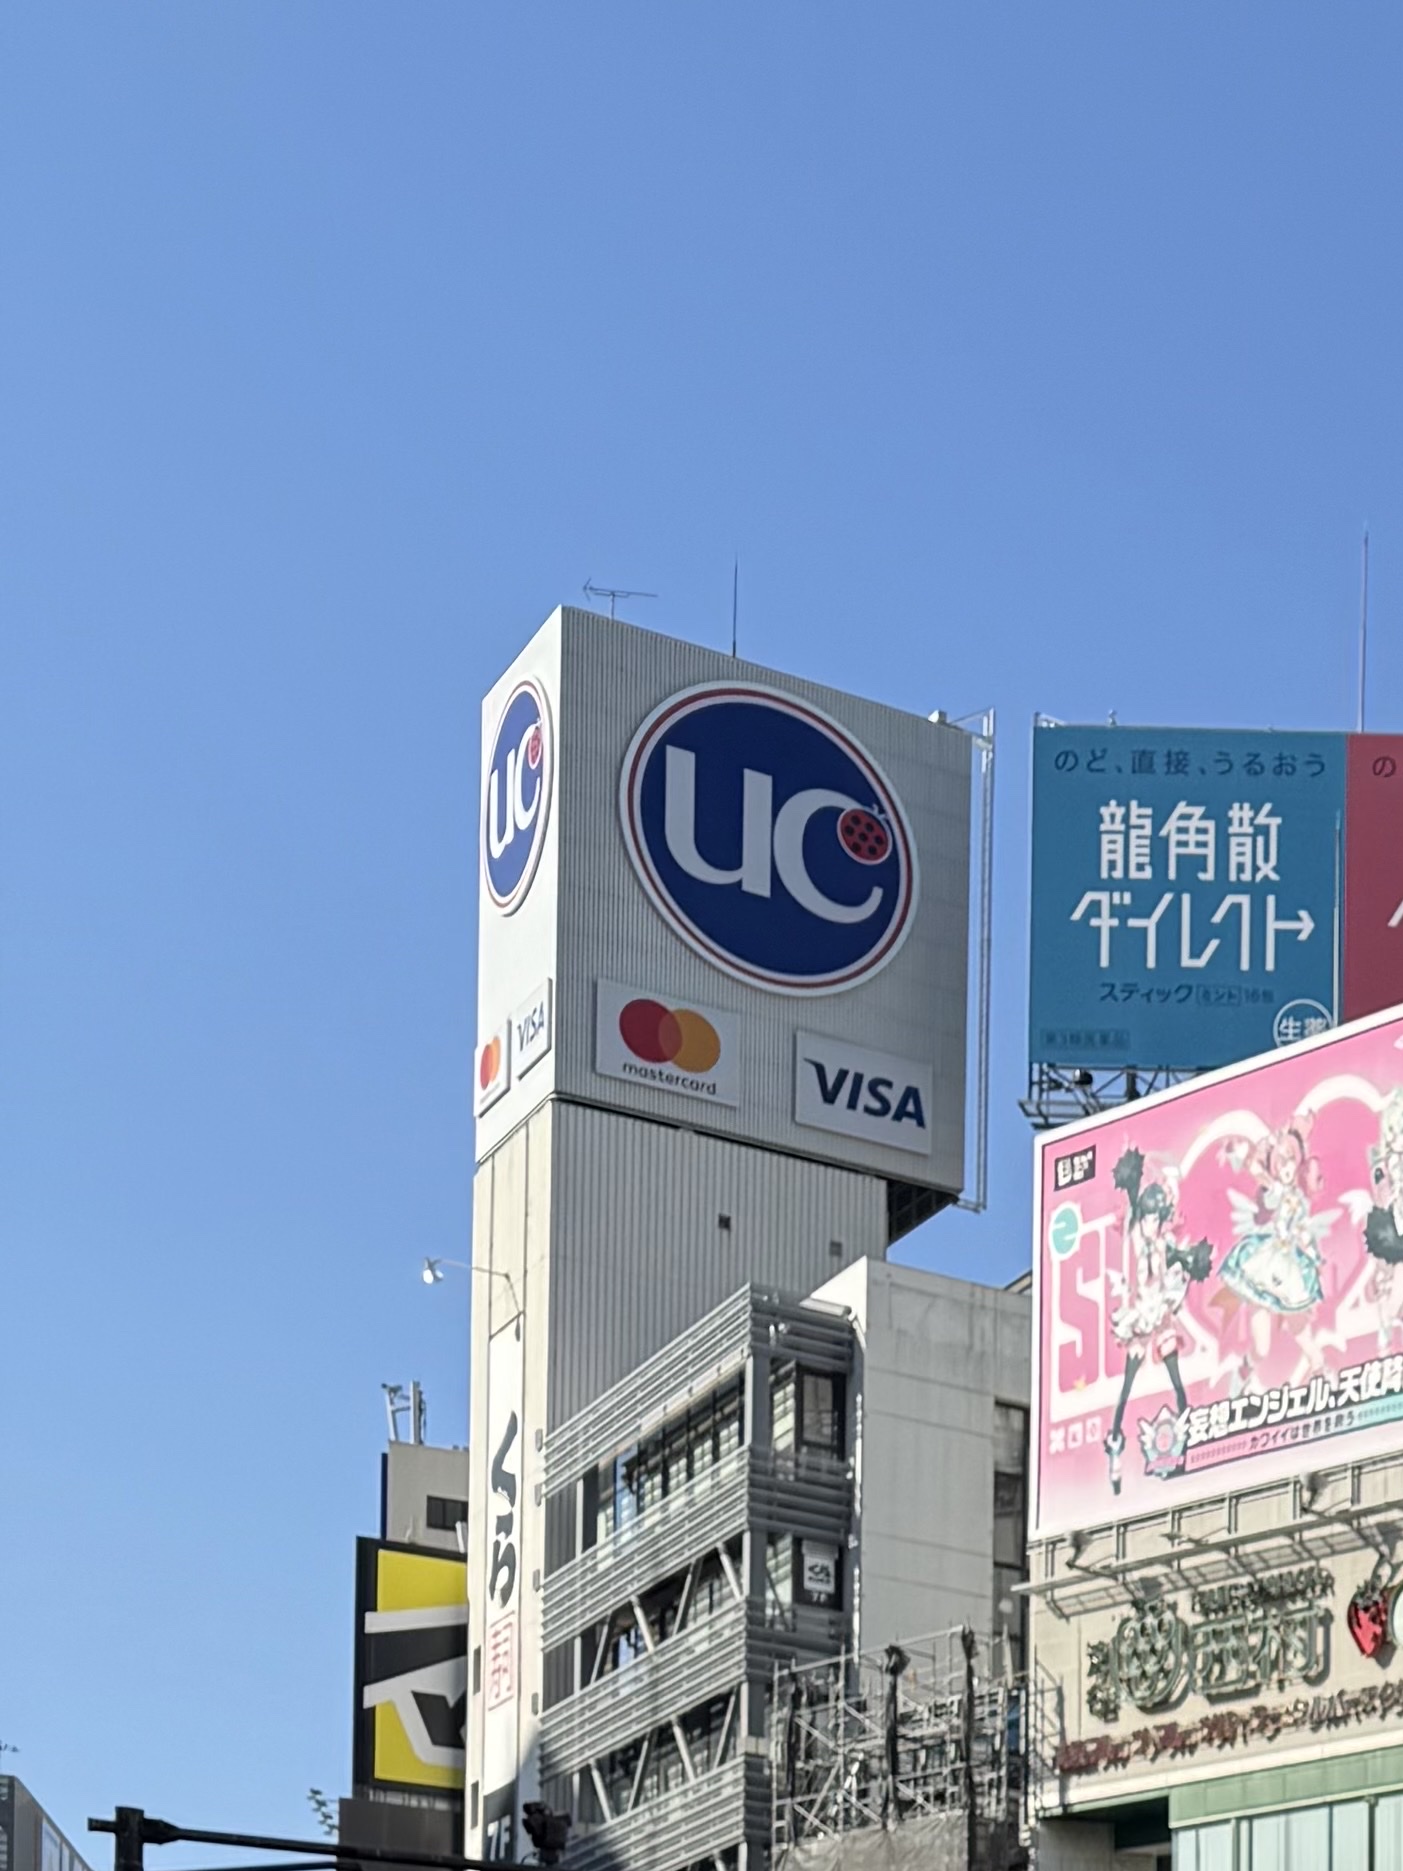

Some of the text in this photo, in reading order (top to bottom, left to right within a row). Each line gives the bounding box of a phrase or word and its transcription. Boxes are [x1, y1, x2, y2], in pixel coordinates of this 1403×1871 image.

[1099, 800, 1283, 883] 龍角散
[1070, 890, 1315, 972] ダイレクト
[516, 1000, 546, 1052] VISA
[622, 1060, 718, 1097] mastercard
[803, 1057, 928, 1131] VISA
[488, 1815, 513, 1862] 7F
